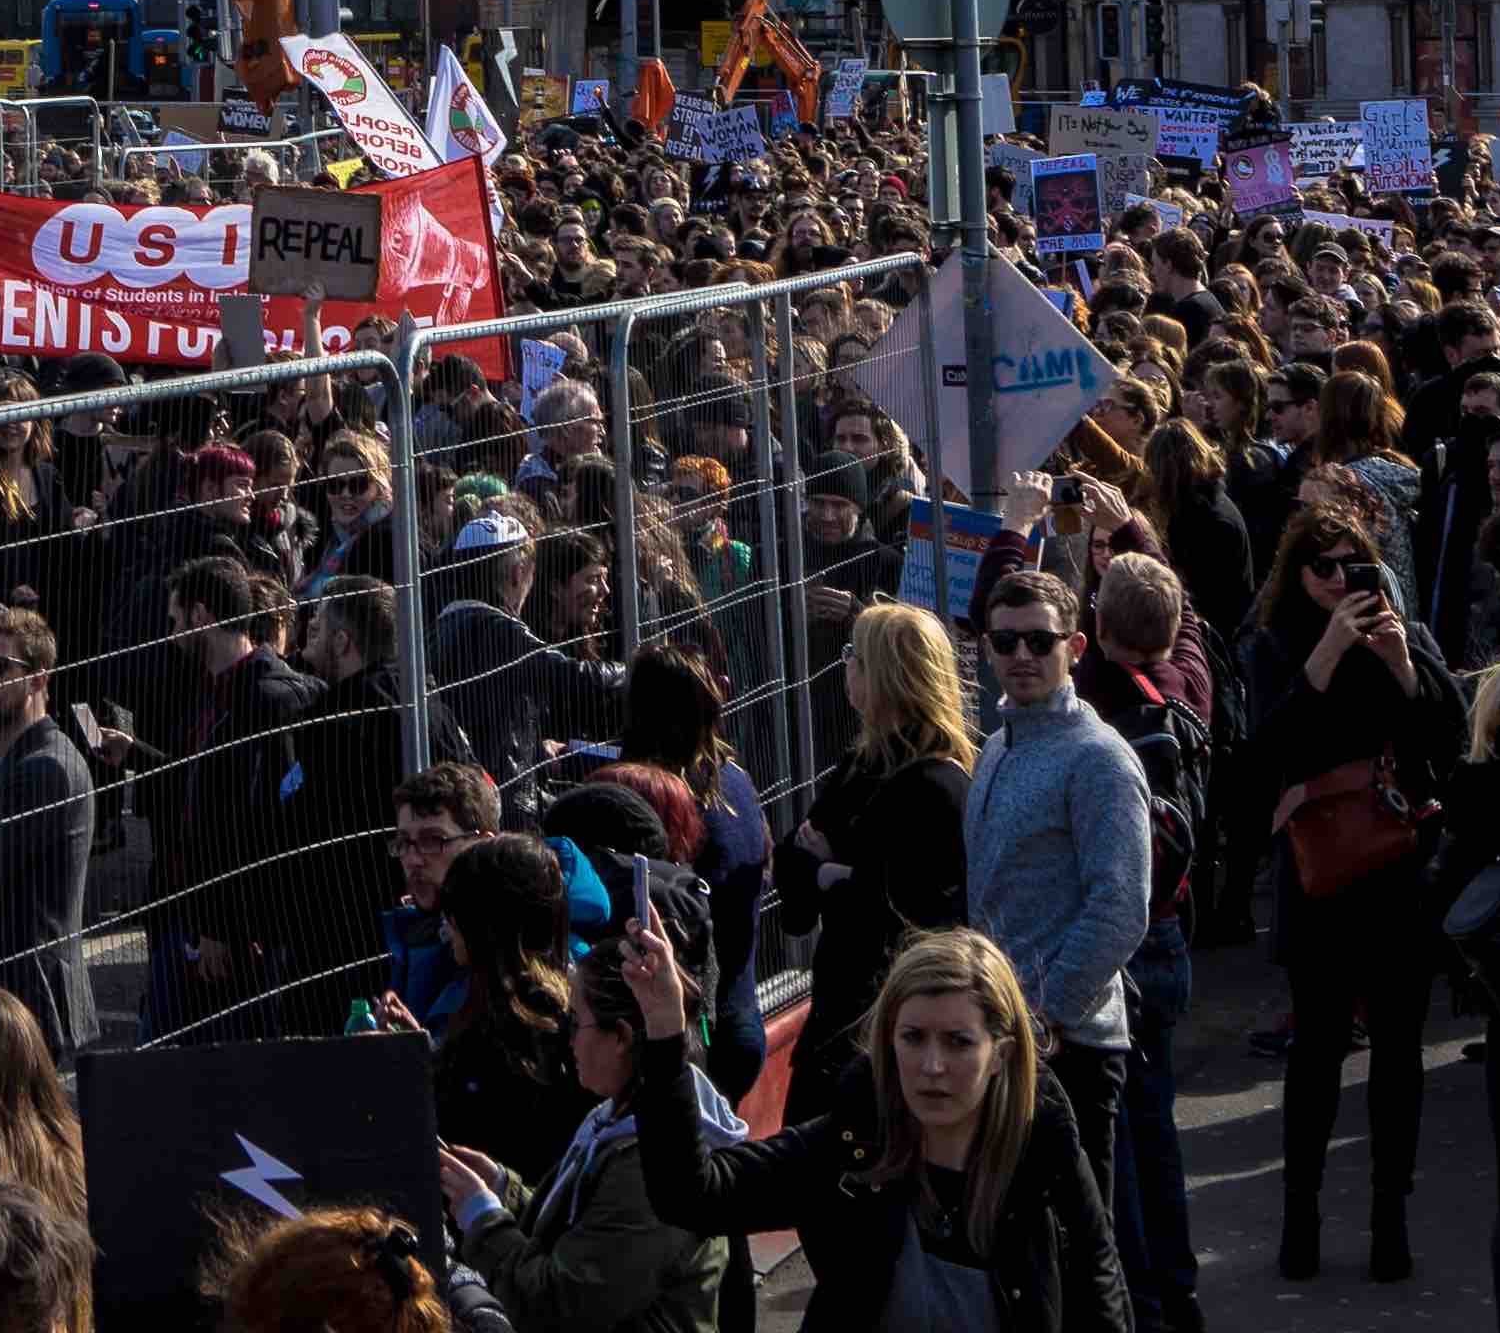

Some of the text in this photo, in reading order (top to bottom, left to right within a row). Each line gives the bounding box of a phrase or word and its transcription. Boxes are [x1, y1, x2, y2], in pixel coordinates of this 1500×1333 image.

[1114, 83, 1145, 104] WE
[221, 111, 272, 131] WOMEN
[1163, 108, 1218, 124] WANTED
[701, 118, 759, 146] WOMAN
[1370, 158, 1430, 177] BODILY
[258, 216, 375, 265] REPEAL
[80, 287, 101, 300] of
[105, 287, 184, 304] Students
[188, 290, 206, 303] in
